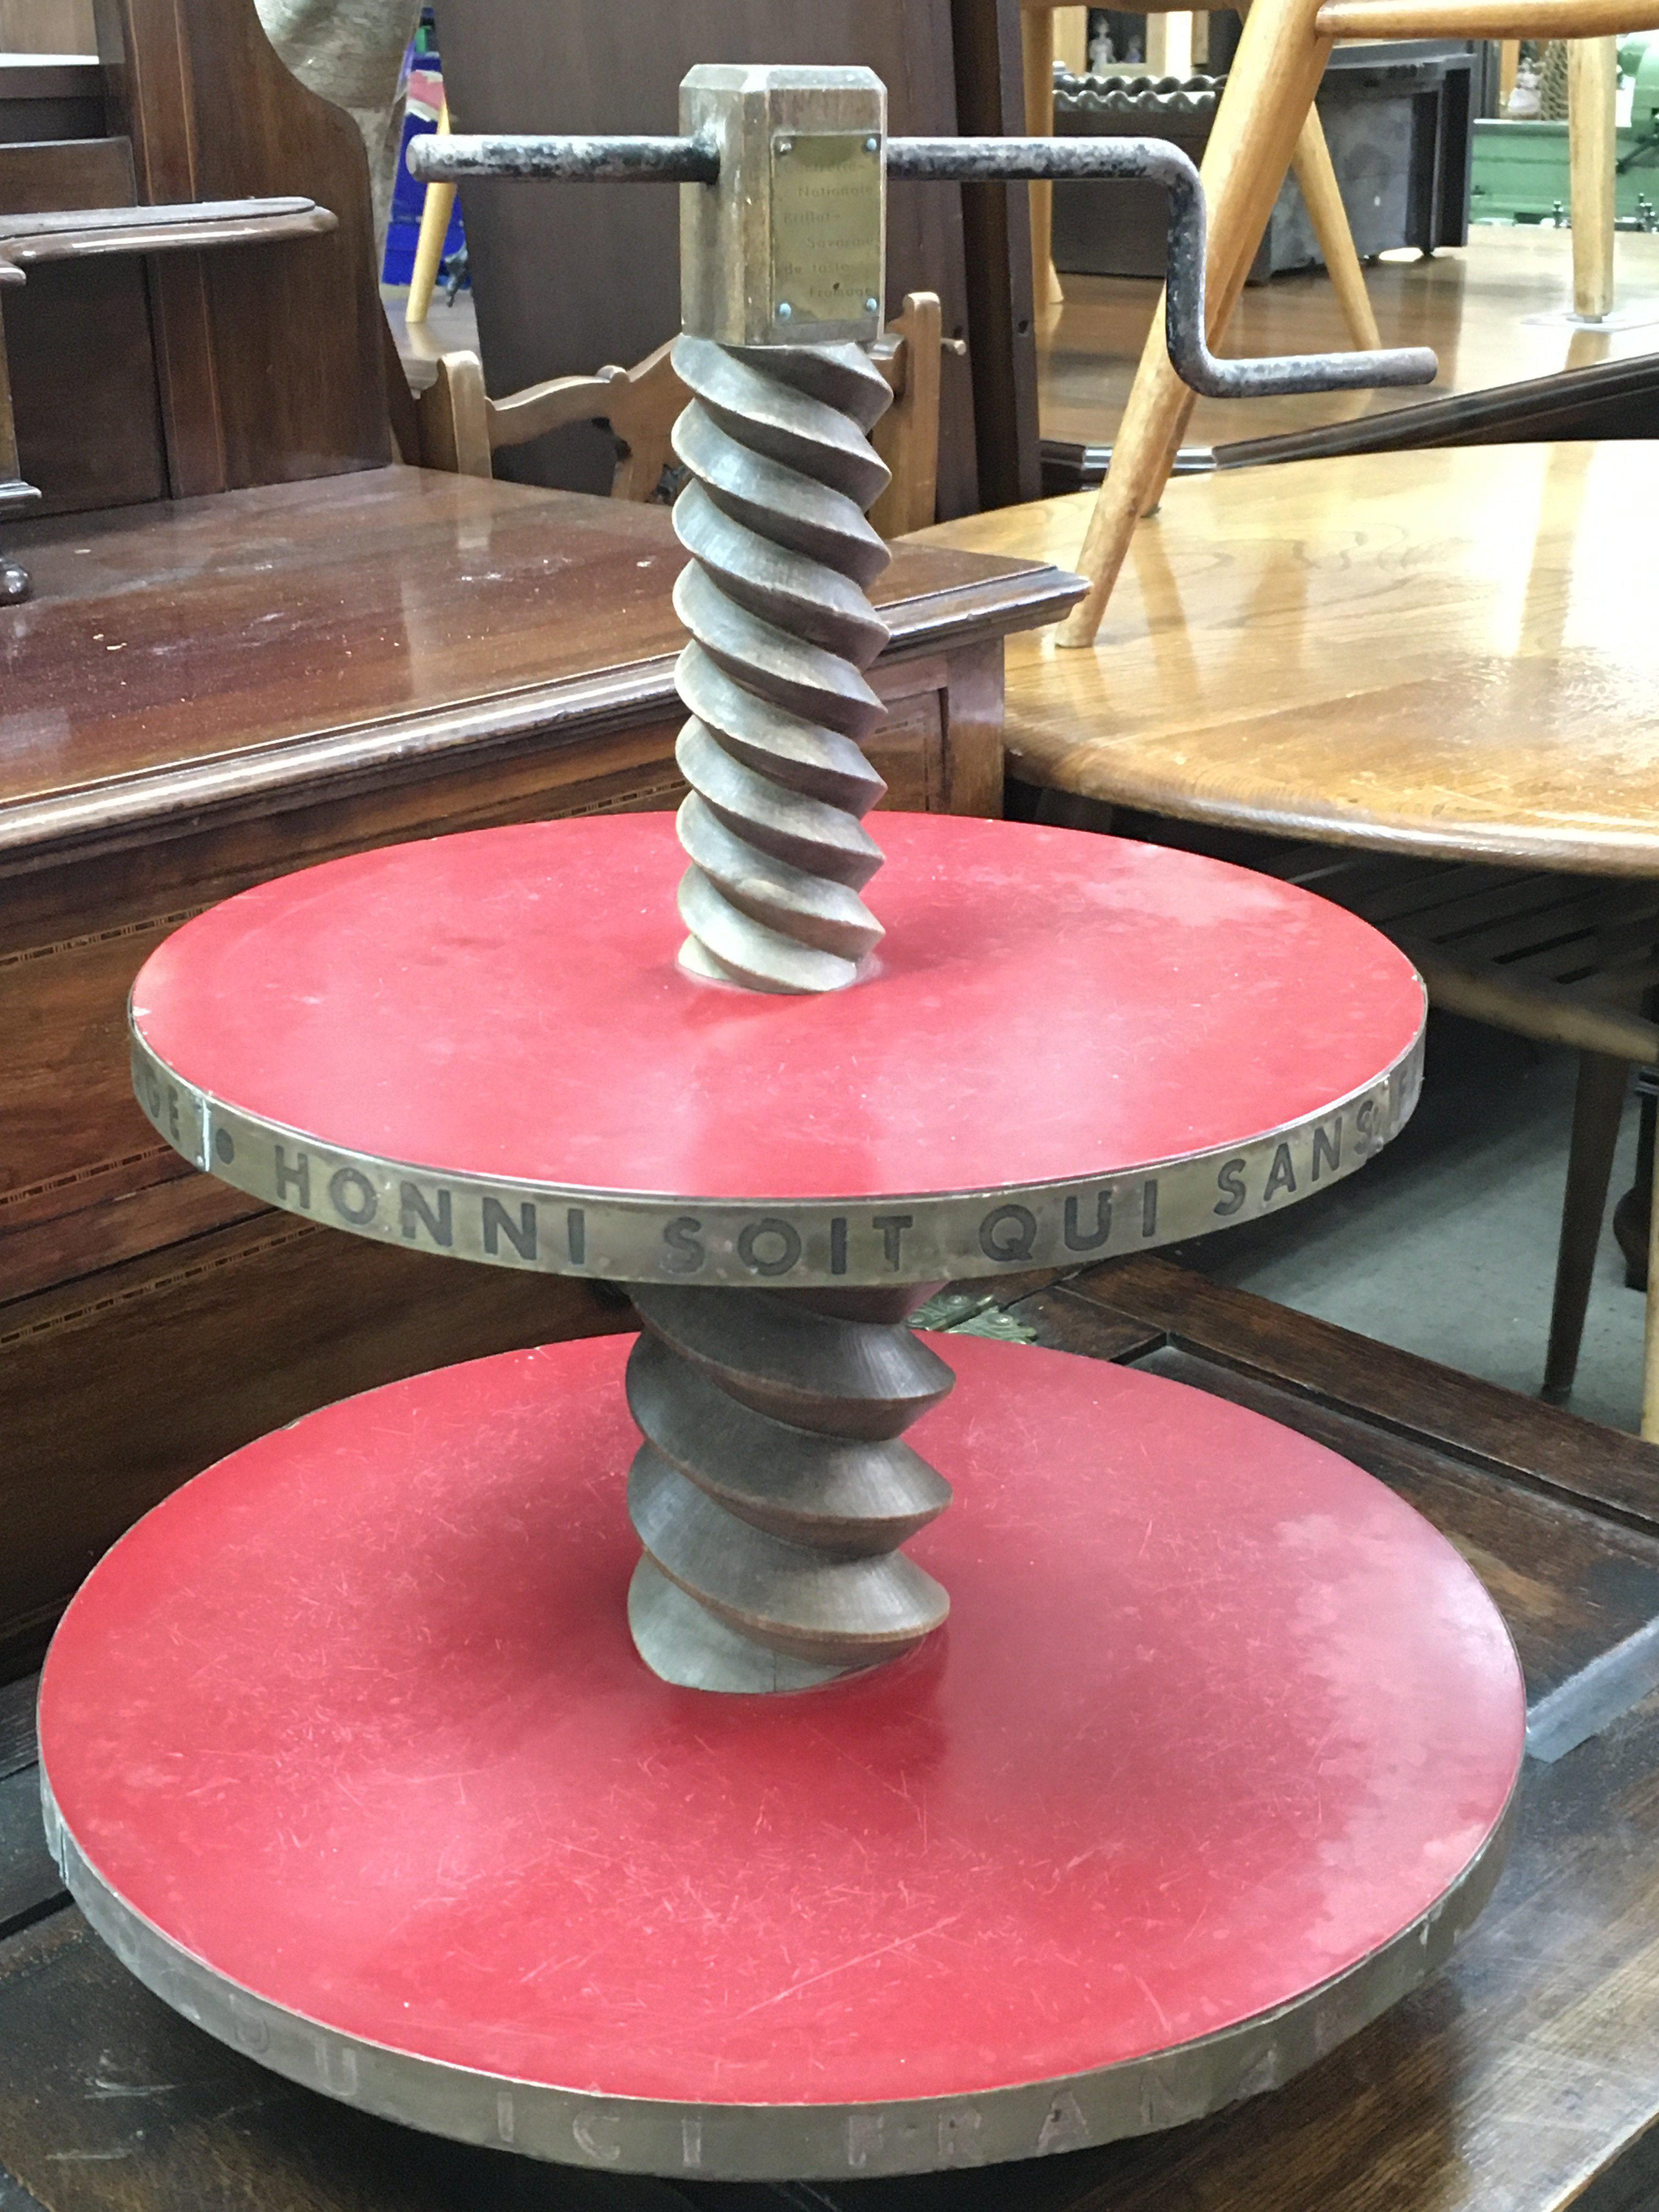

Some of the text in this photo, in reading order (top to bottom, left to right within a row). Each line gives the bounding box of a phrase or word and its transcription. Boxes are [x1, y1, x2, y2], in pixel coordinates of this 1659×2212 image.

[275, 1099, 1379, 1276] HONNI SOIT QUI SANS
